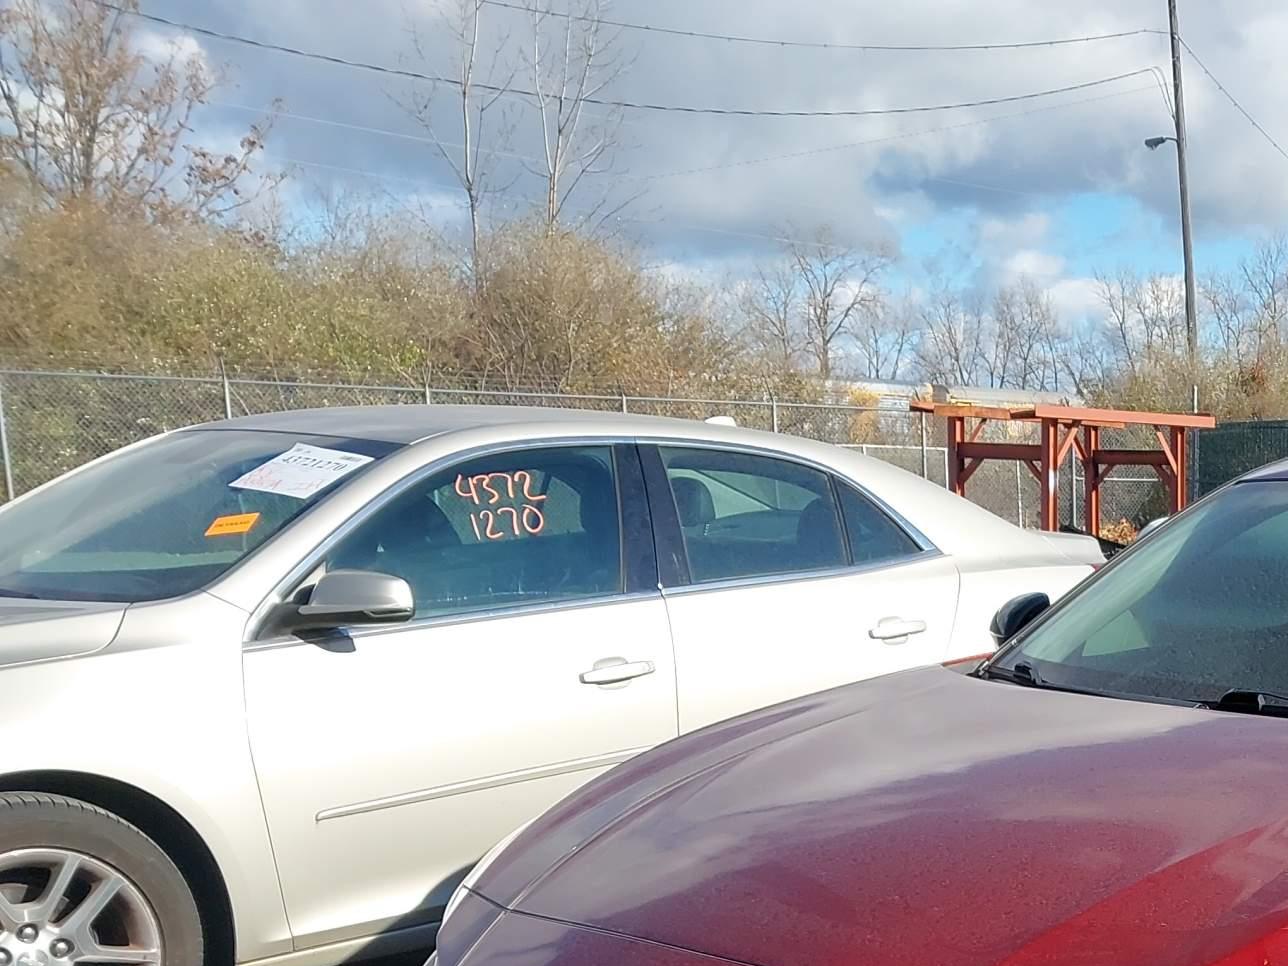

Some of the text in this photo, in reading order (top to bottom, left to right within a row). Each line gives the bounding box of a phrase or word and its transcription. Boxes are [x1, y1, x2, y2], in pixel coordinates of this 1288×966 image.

[282, 456, 348, 471] 43721270
[455, 471, 547, 504] 4372
[470, 504, 544, 541] 1270
